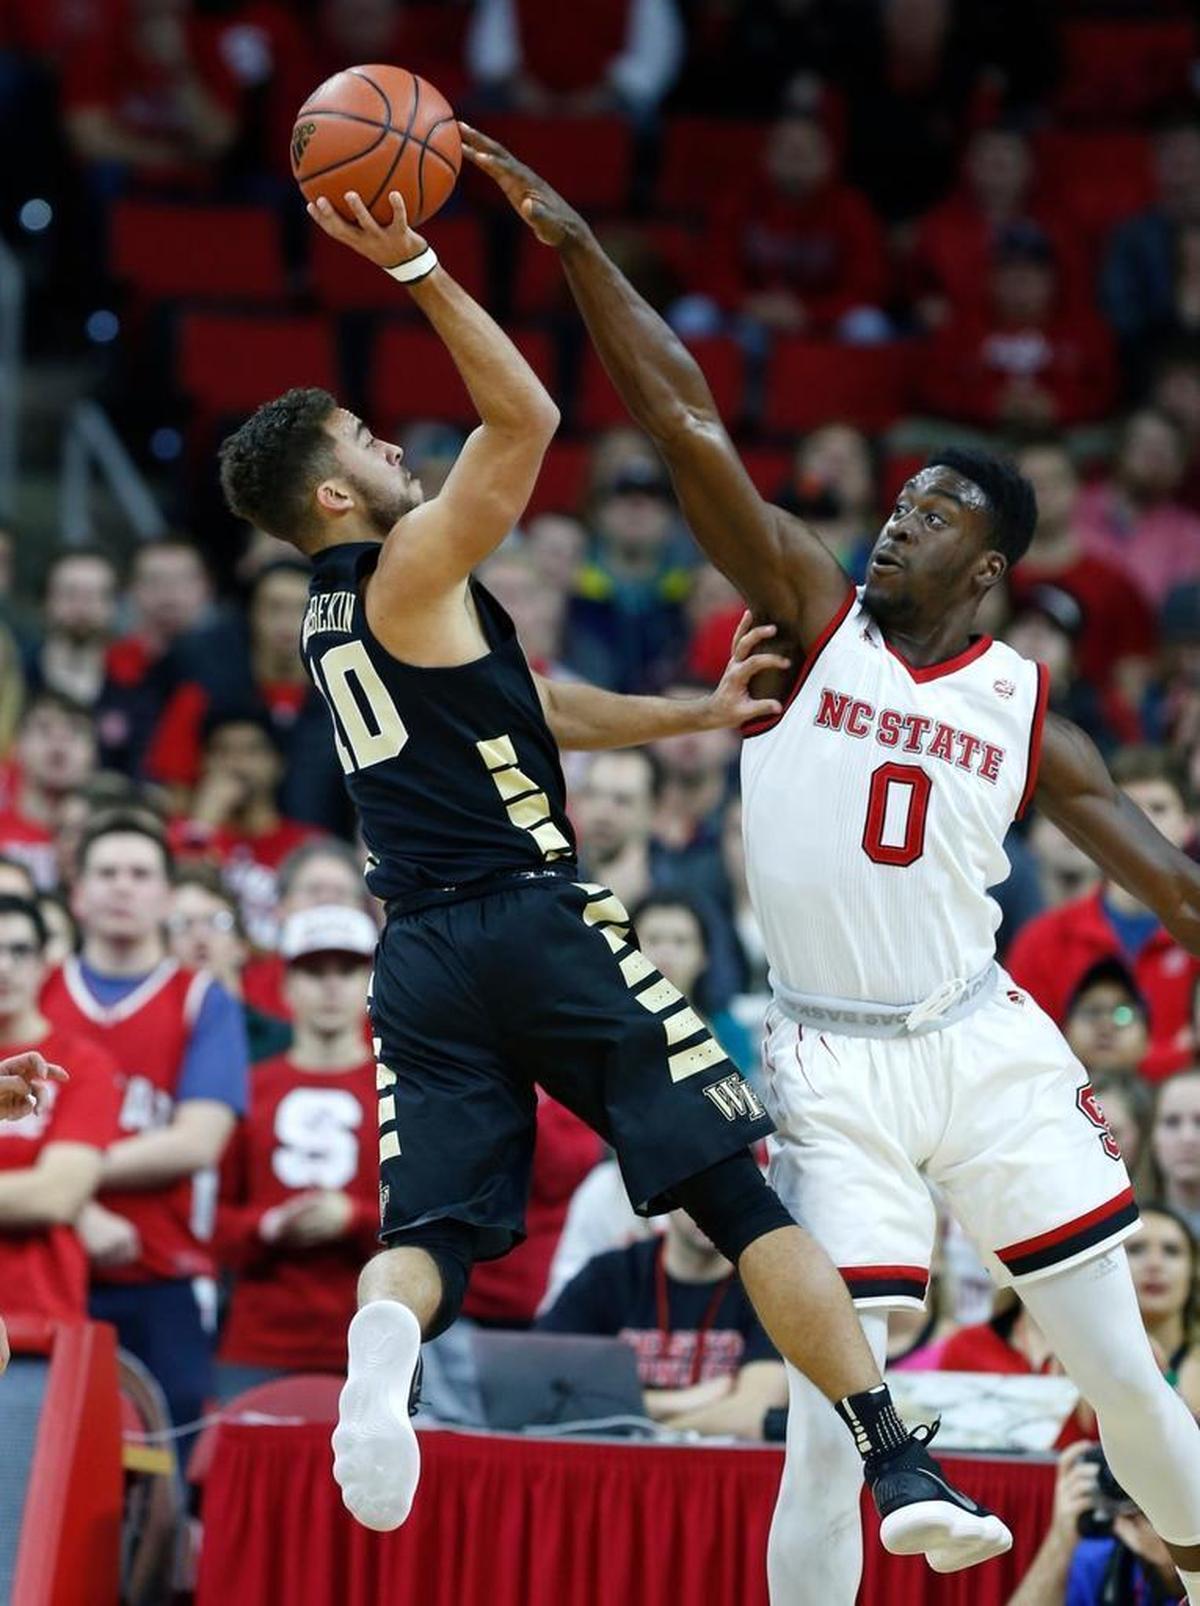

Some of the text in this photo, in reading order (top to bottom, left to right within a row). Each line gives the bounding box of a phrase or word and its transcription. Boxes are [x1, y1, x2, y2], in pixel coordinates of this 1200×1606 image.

[814, 687, 1006, 785] NC STATE
[861, 761, 933, 868] 0
